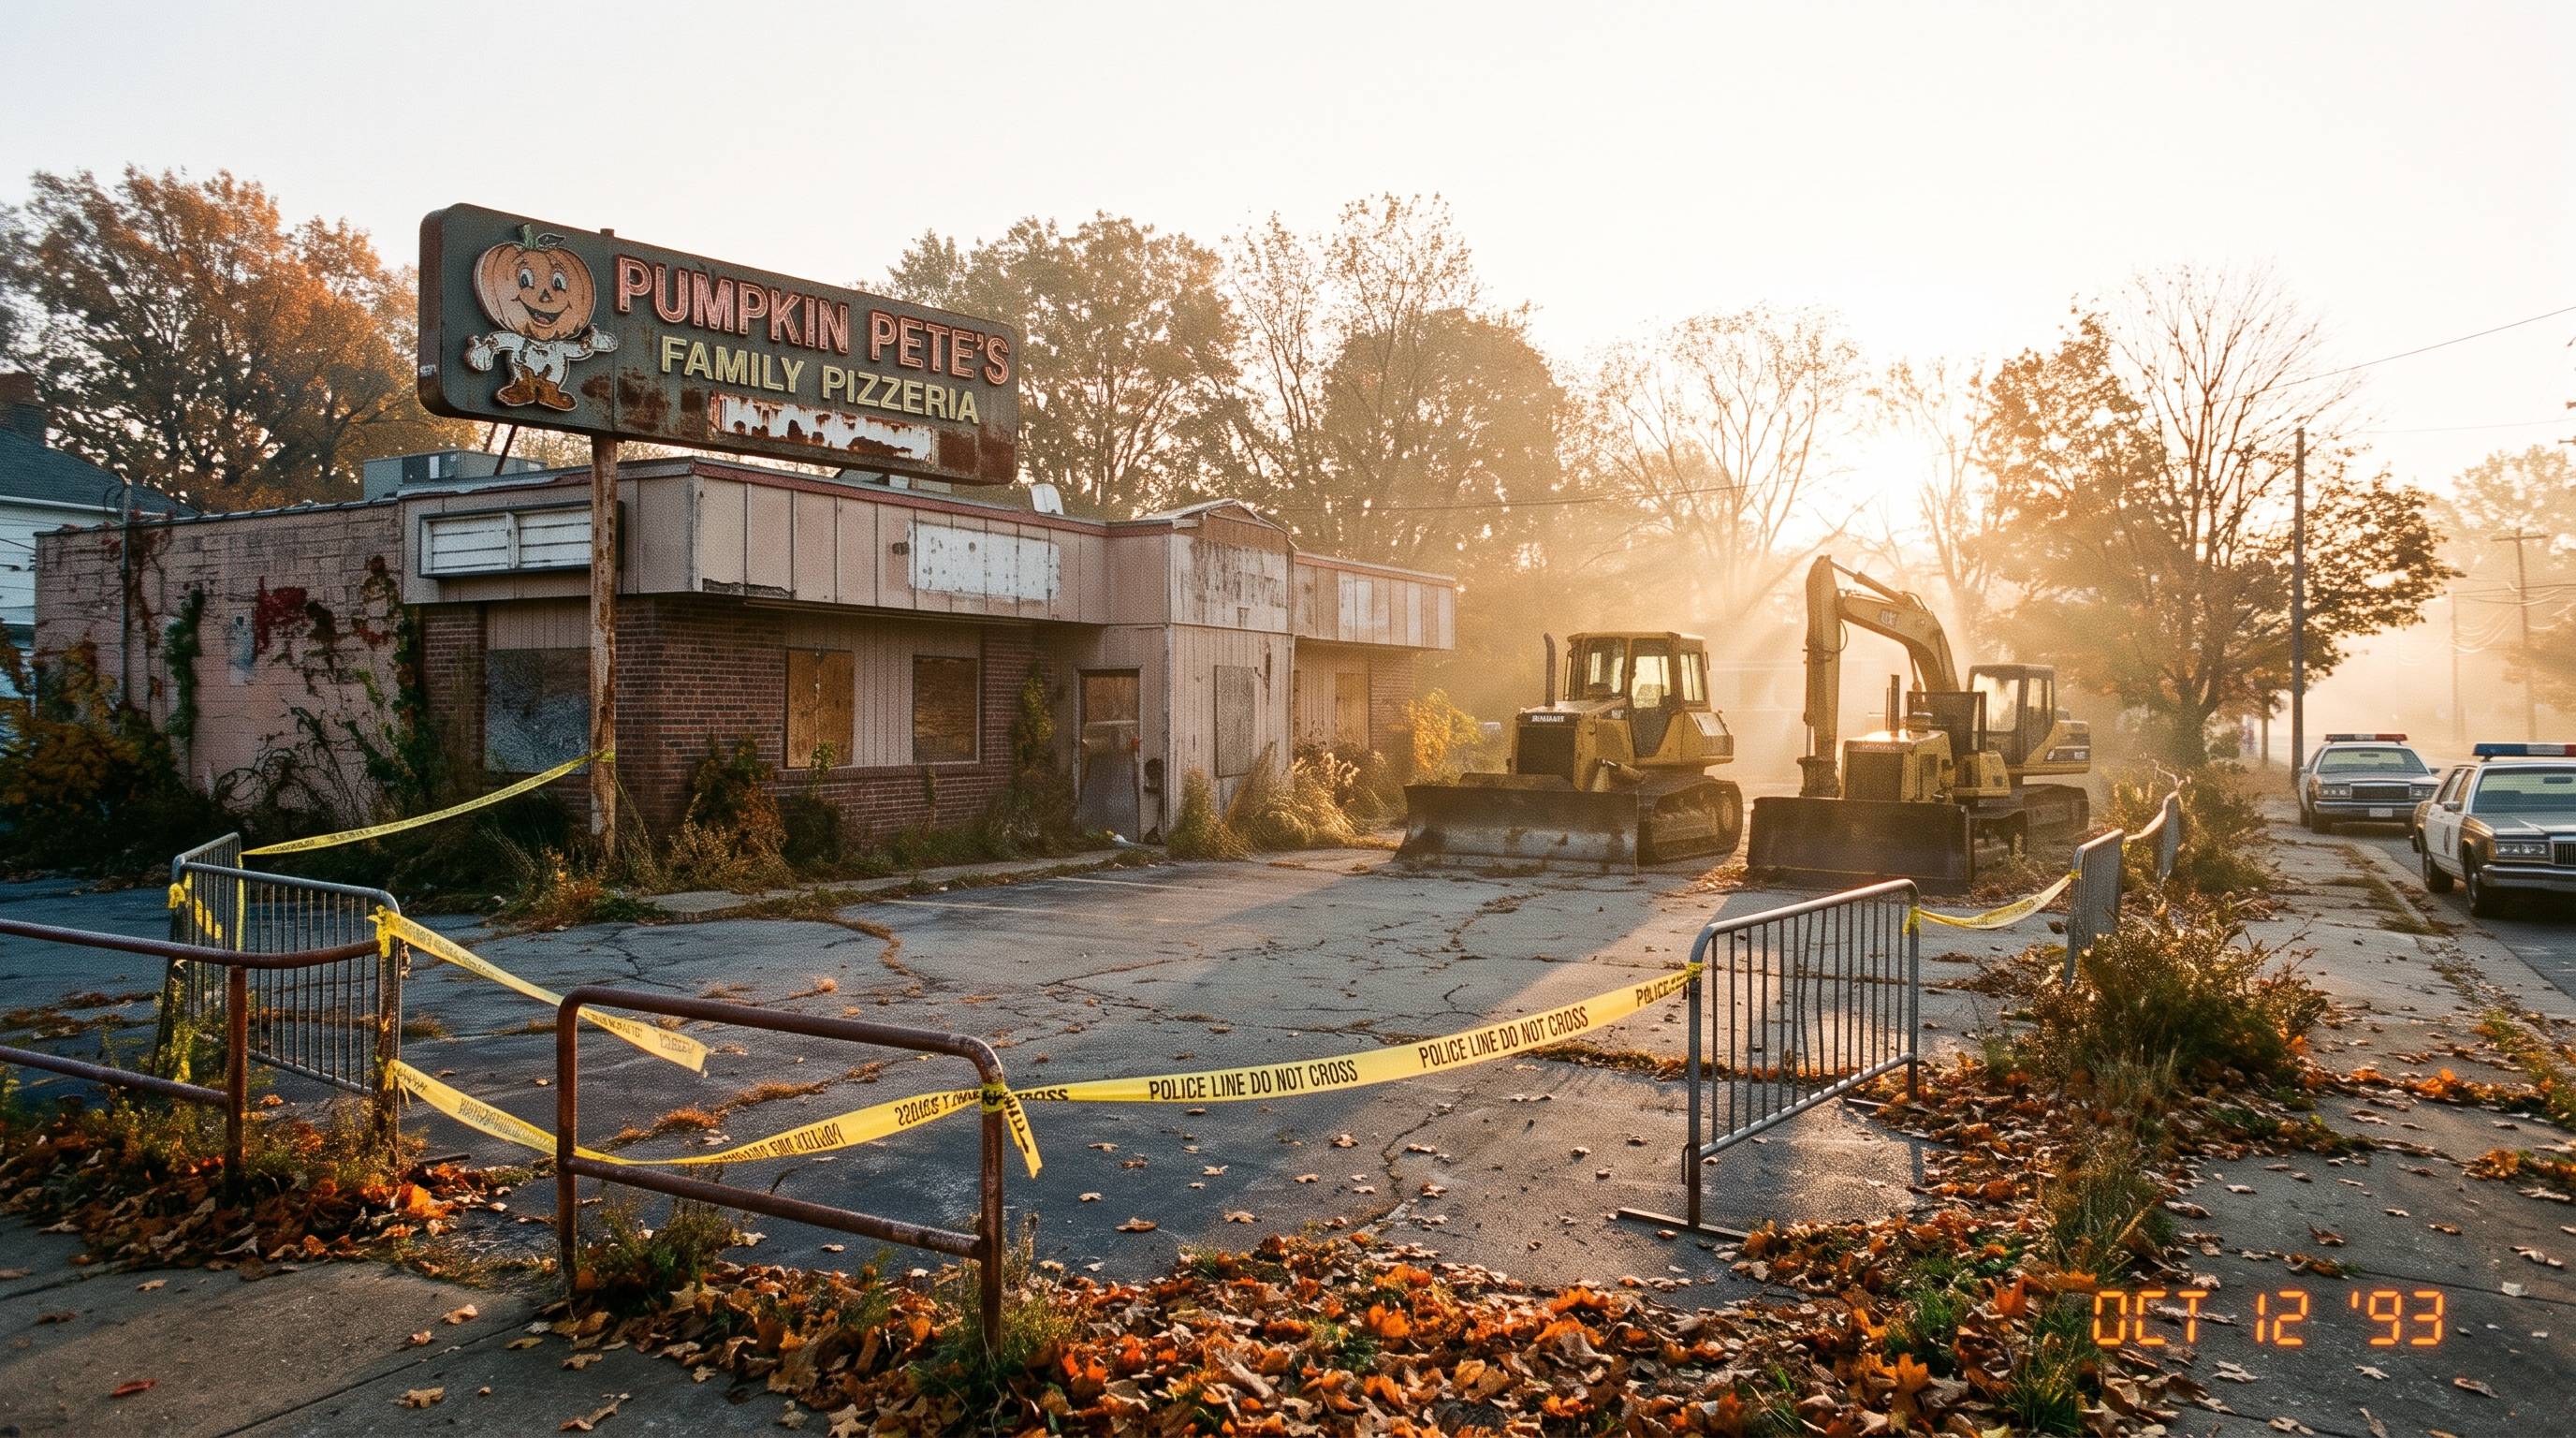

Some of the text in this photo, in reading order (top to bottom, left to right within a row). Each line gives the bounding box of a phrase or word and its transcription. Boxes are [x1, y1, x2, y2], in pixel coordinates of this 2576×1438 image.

[616, 254, 1011, 387] PUMPKIN PETE'S
[662, 335, 980, 424] FAMILY PIZZERIA
[1418, 1005, 1588, 1069] POLICE LINE DO NOT CROSS
[1149, 1059, 1358, 1100] POLICE LINE DO NOT CROSS
